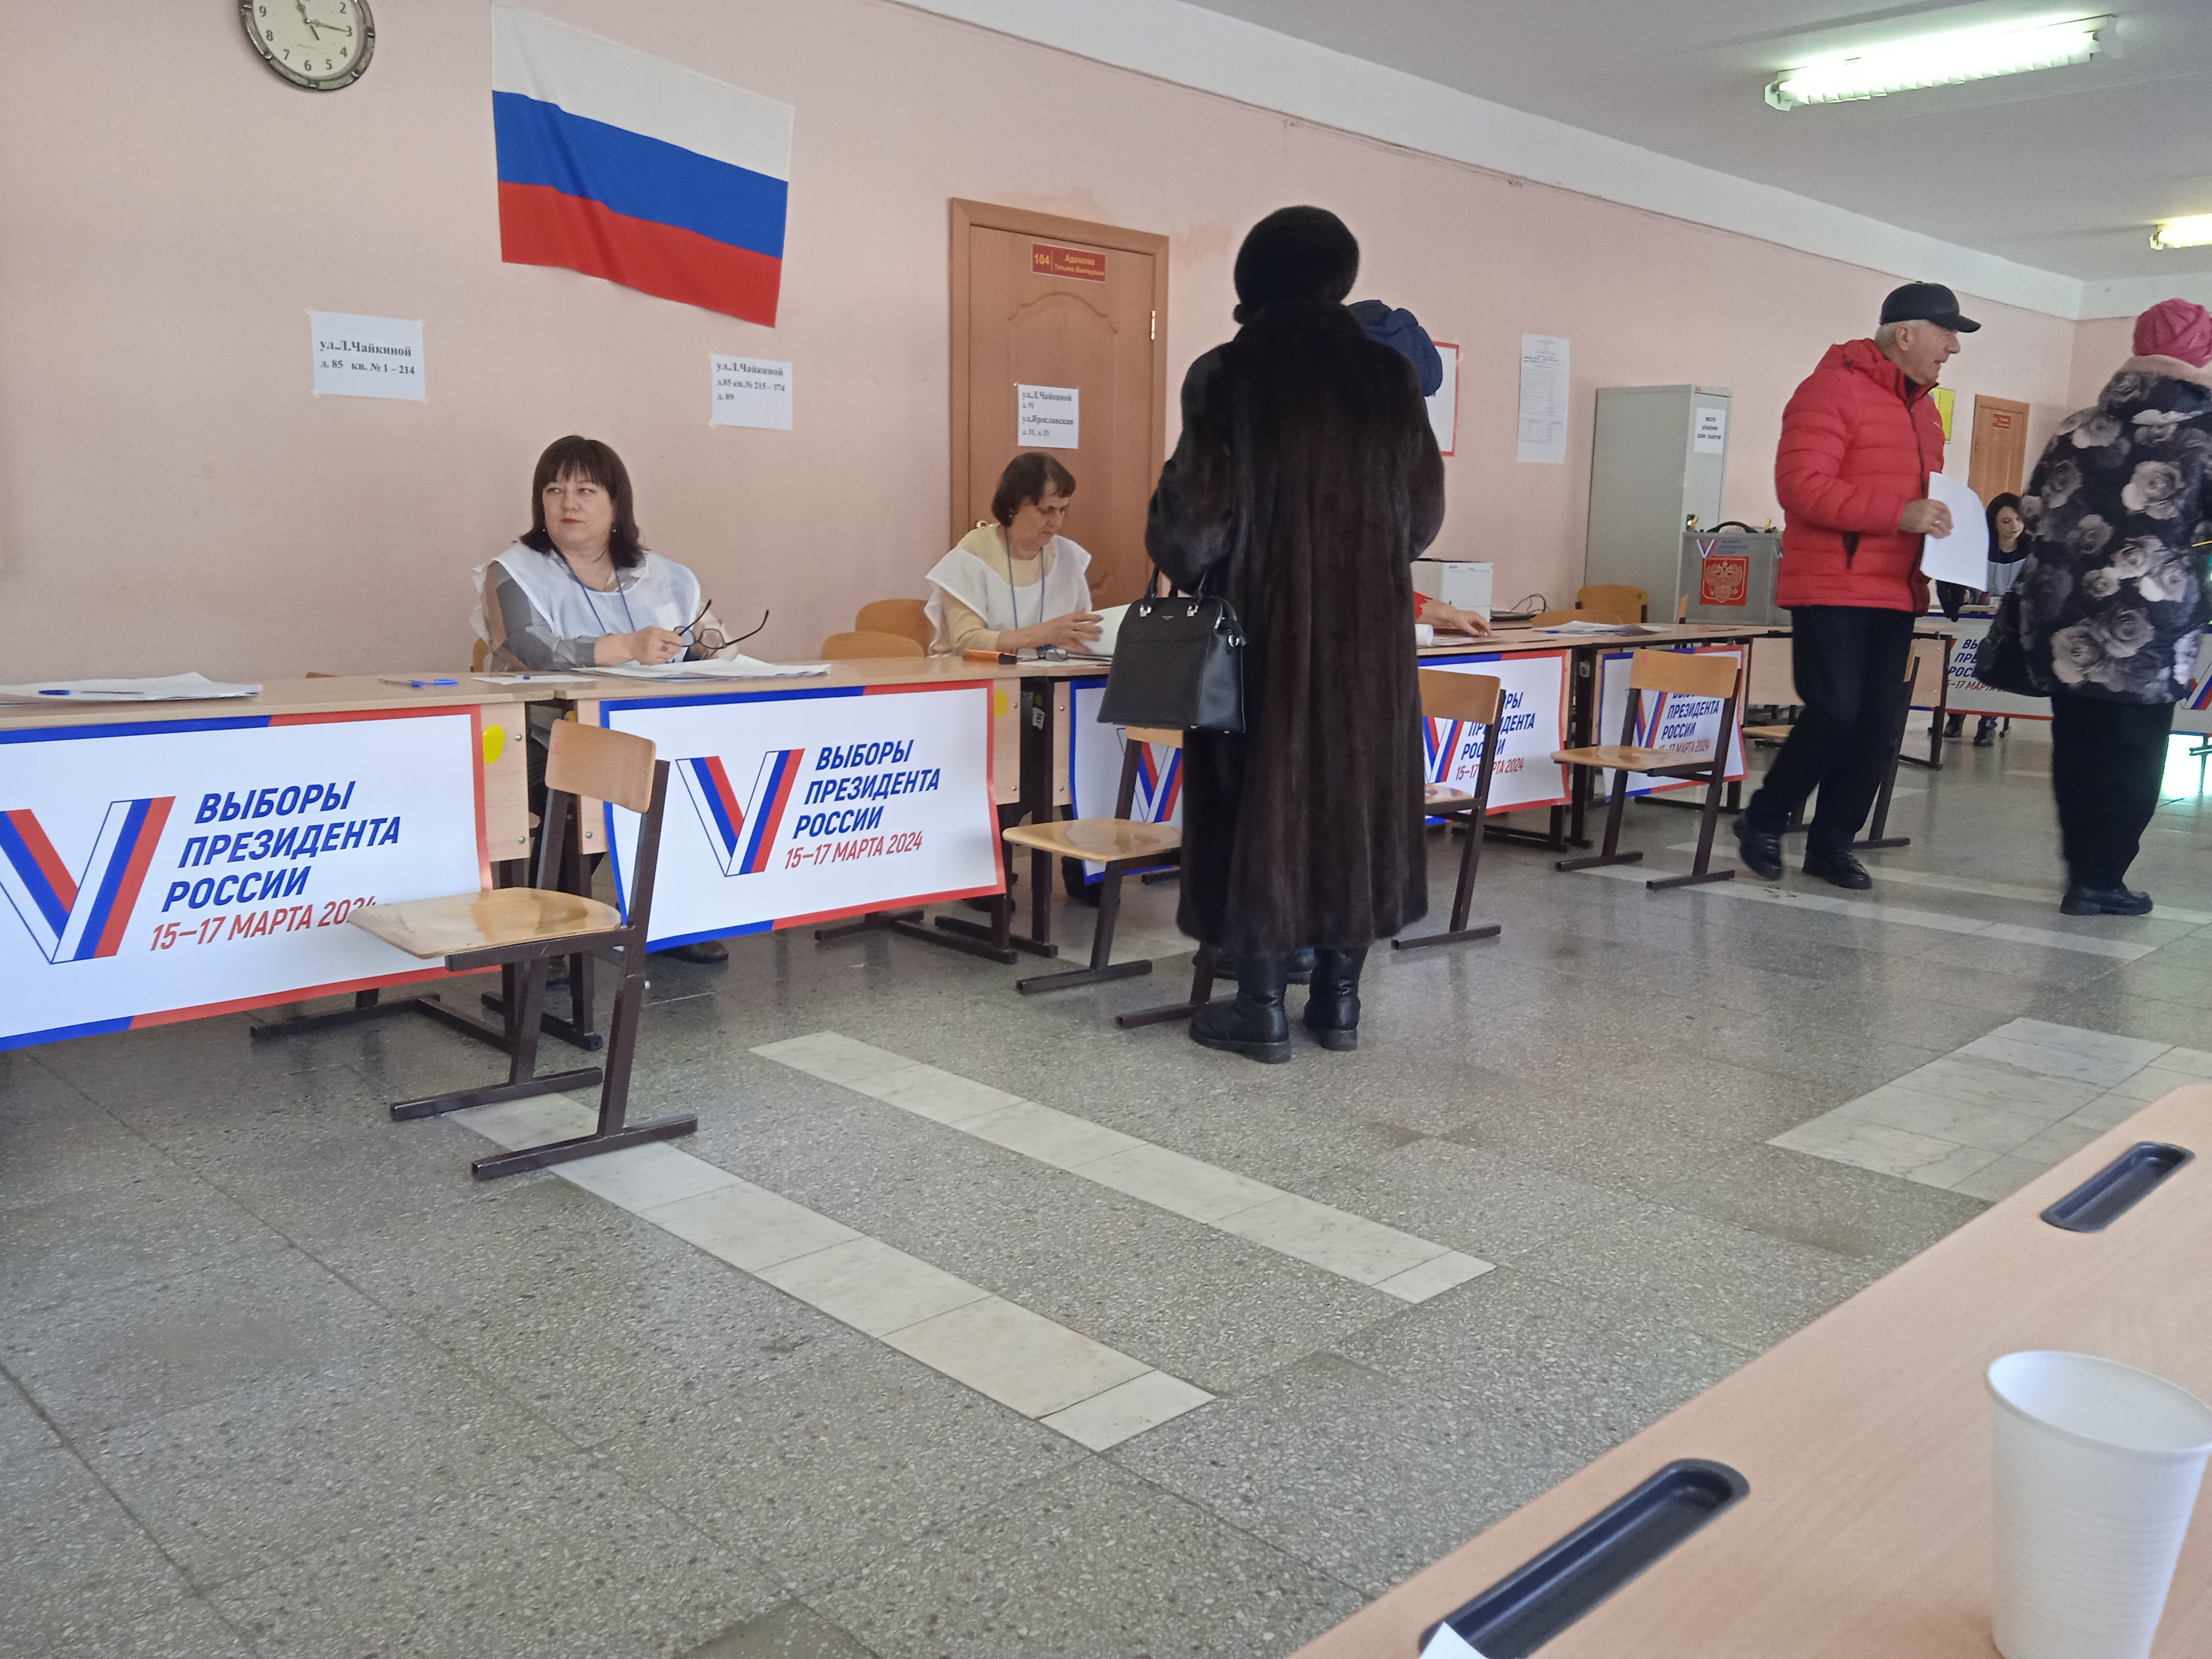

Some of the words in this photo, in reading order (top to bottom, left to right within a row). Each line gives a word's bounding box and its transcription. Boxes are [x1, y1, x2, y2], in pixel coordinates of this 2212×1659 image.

[259, 6, 267, 17] 9
[339, 2, 347, 14] 2
[266, 30, 274, 41] 8
[283, 49, 290, 60] 7
[340, 47, 347, 57] 4
[304, 60, 312, 71] 6
[326, 59, 333, 70] 5
[1034, 254, 1050, 266] 104
[331, 359, 343, 369] 85
[351, 363, 367, 371] кв.
[370, 363, 381, 372] №
[384, 364, 388, 372] 1
[399, 365, 415, 374] 214
[1948, 666, 1976, 678] РОС
[1666, 699, 1721, 720] ПРЕЗИДЕНТА
[1468, 713, 1536, 737] ПРДЕНТА
[1661, 722, 1697, 740] РОССИИ
[815, 739, 915, 771] ВЫБОРЫ
[1461, 738, 1506, 760] РОСИ
[1504, 757, 1524, 773] 2024
[803, 768, 941, 806] ПРЕЗИДЕНТА
[194, 781, 356, 824] ВЫБОРЫ
[792, 806, 885, 840] РОССИИ
[177, 816, 401, 868] ПРЕЗИДЕНТА
[784, 843, 832, 869] 15–17
[831, 835, 884, 863] МАРТА
[885, 831, 923, 855] 2024
[161, 866, 312, 913] РОССИИ
[150, 916, 227, 951] 15–17
[227, 904, 314, 941] МАРТА
